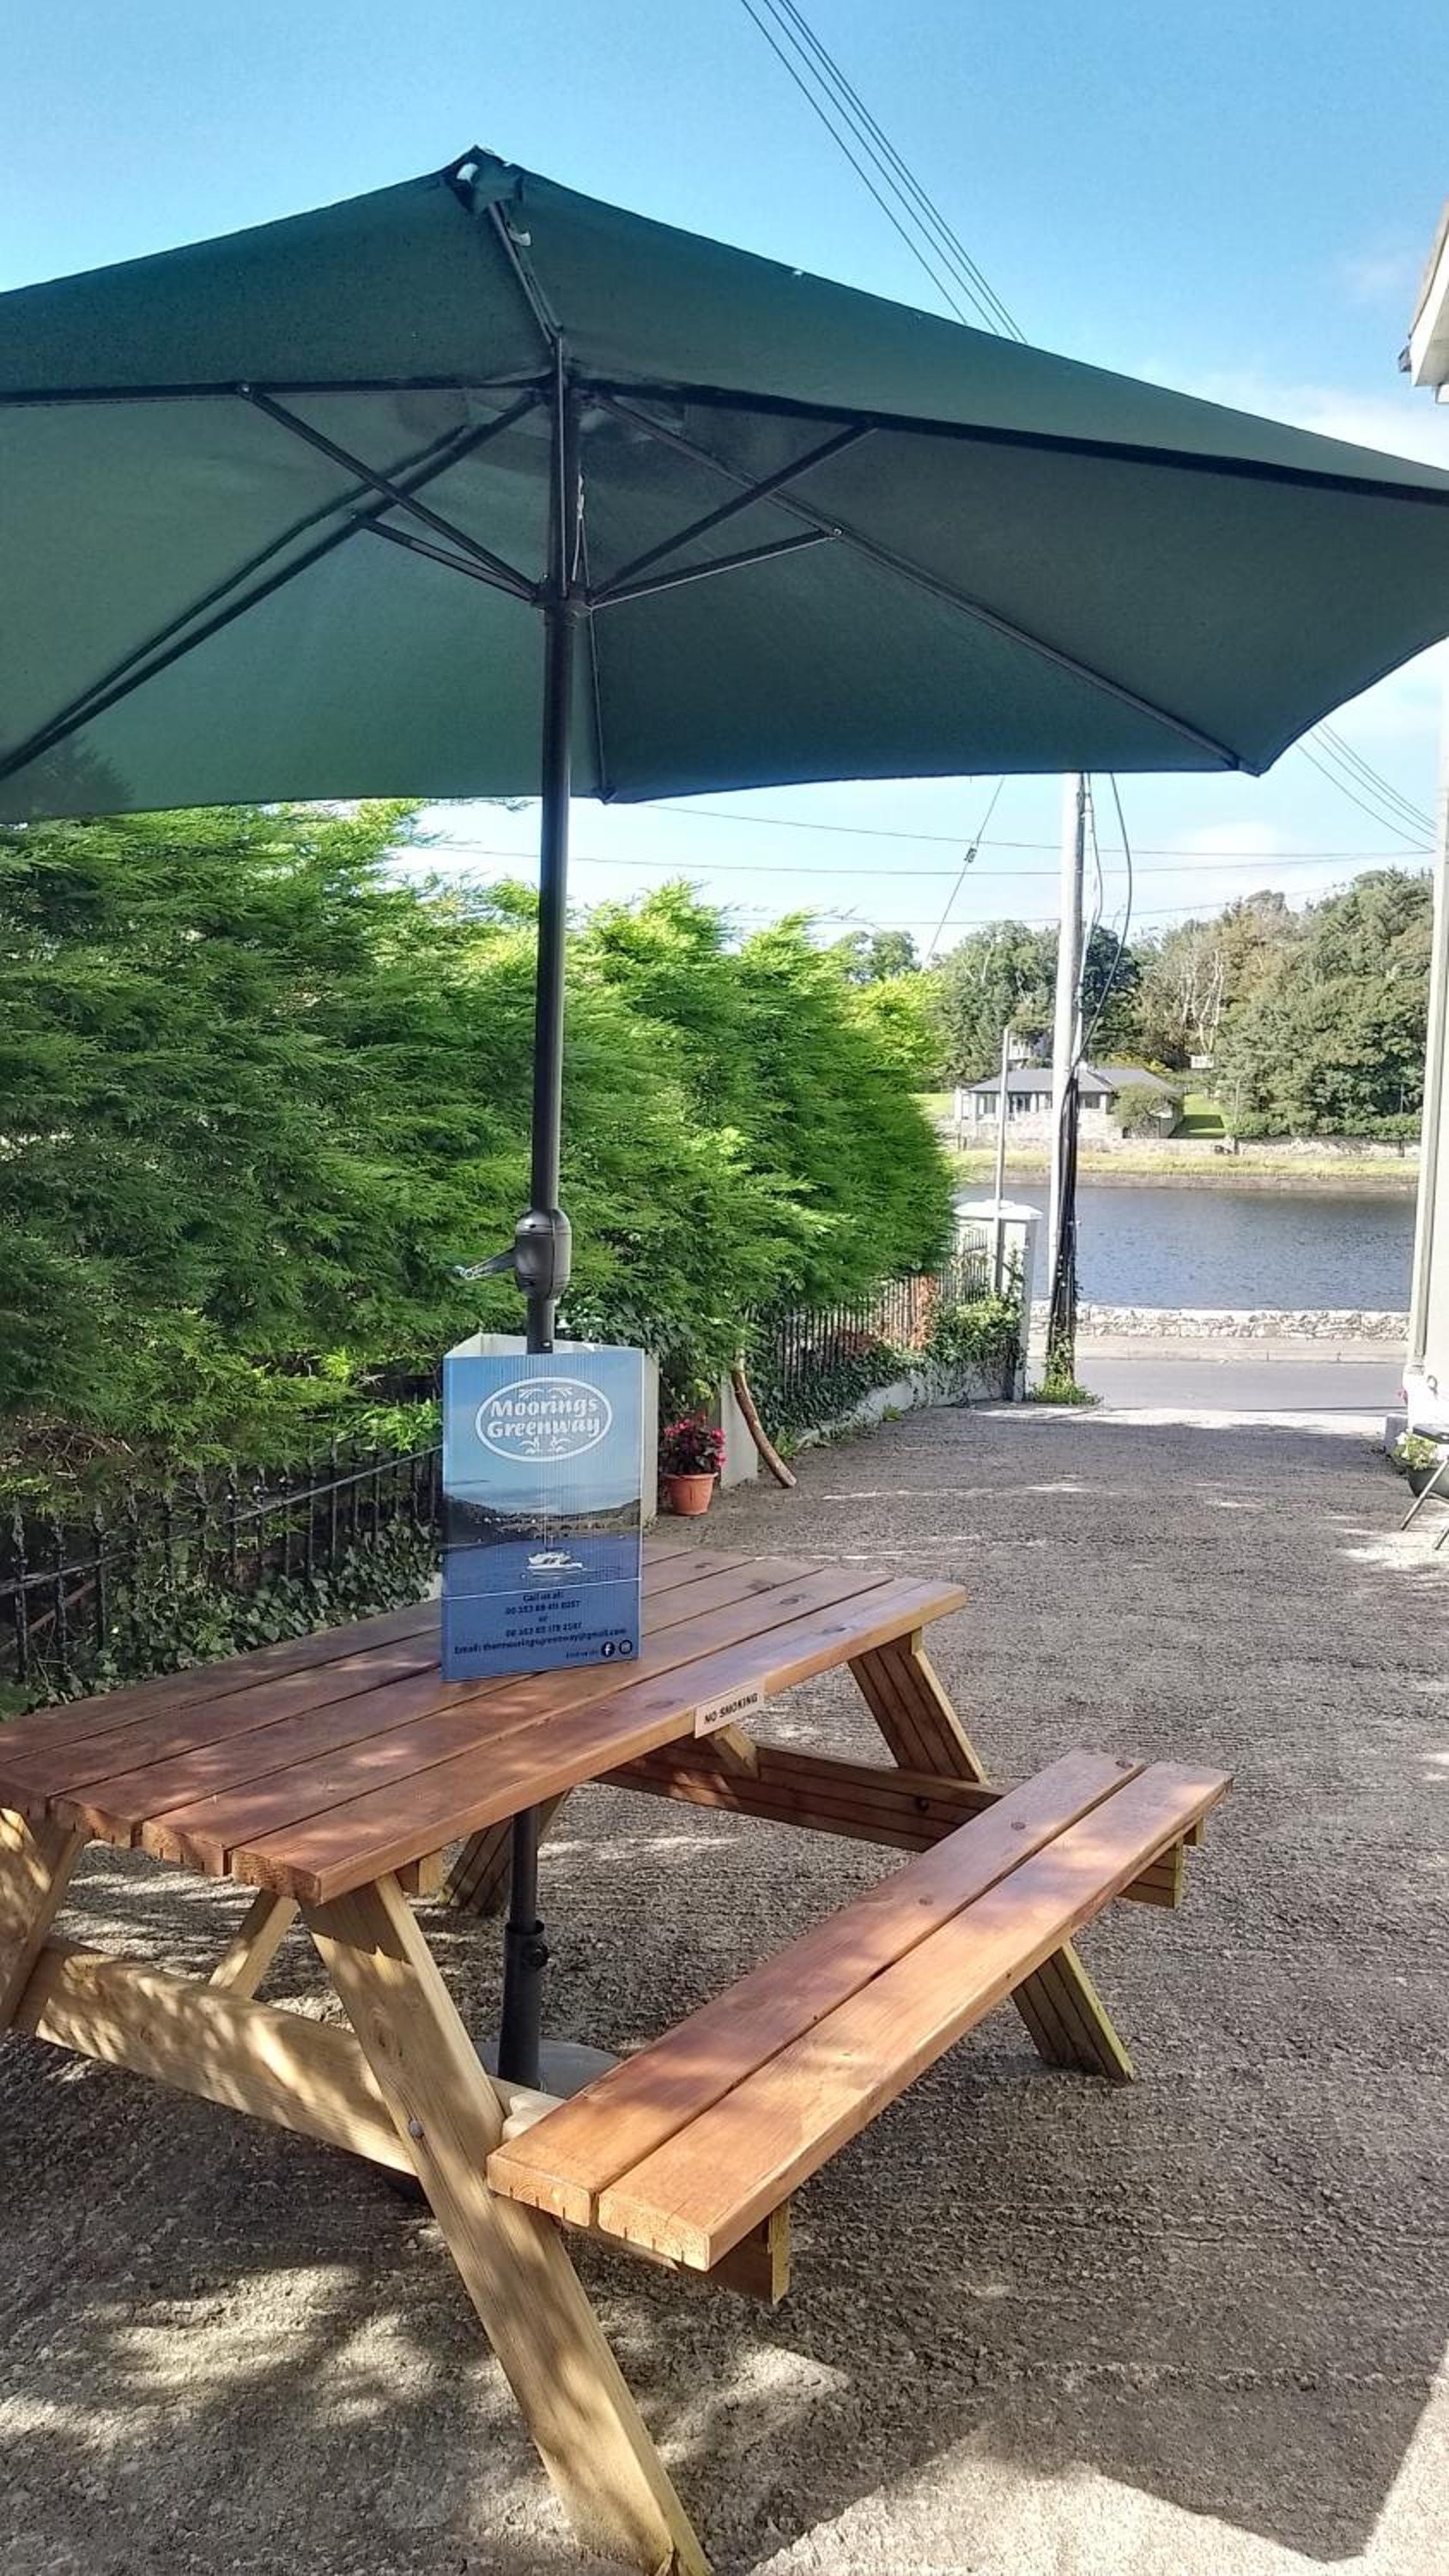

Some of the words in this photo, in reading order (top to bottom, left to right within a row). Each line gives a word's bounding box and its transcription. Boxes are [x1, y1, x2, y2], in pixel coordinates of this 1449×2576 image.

[491, 1396, 598, 1418] Moorings
[487, 1418, 600, 1438] Greenway
[705, 1710, 718, 1722] NO
[719, 1692, 758, 1718] SMOKING
